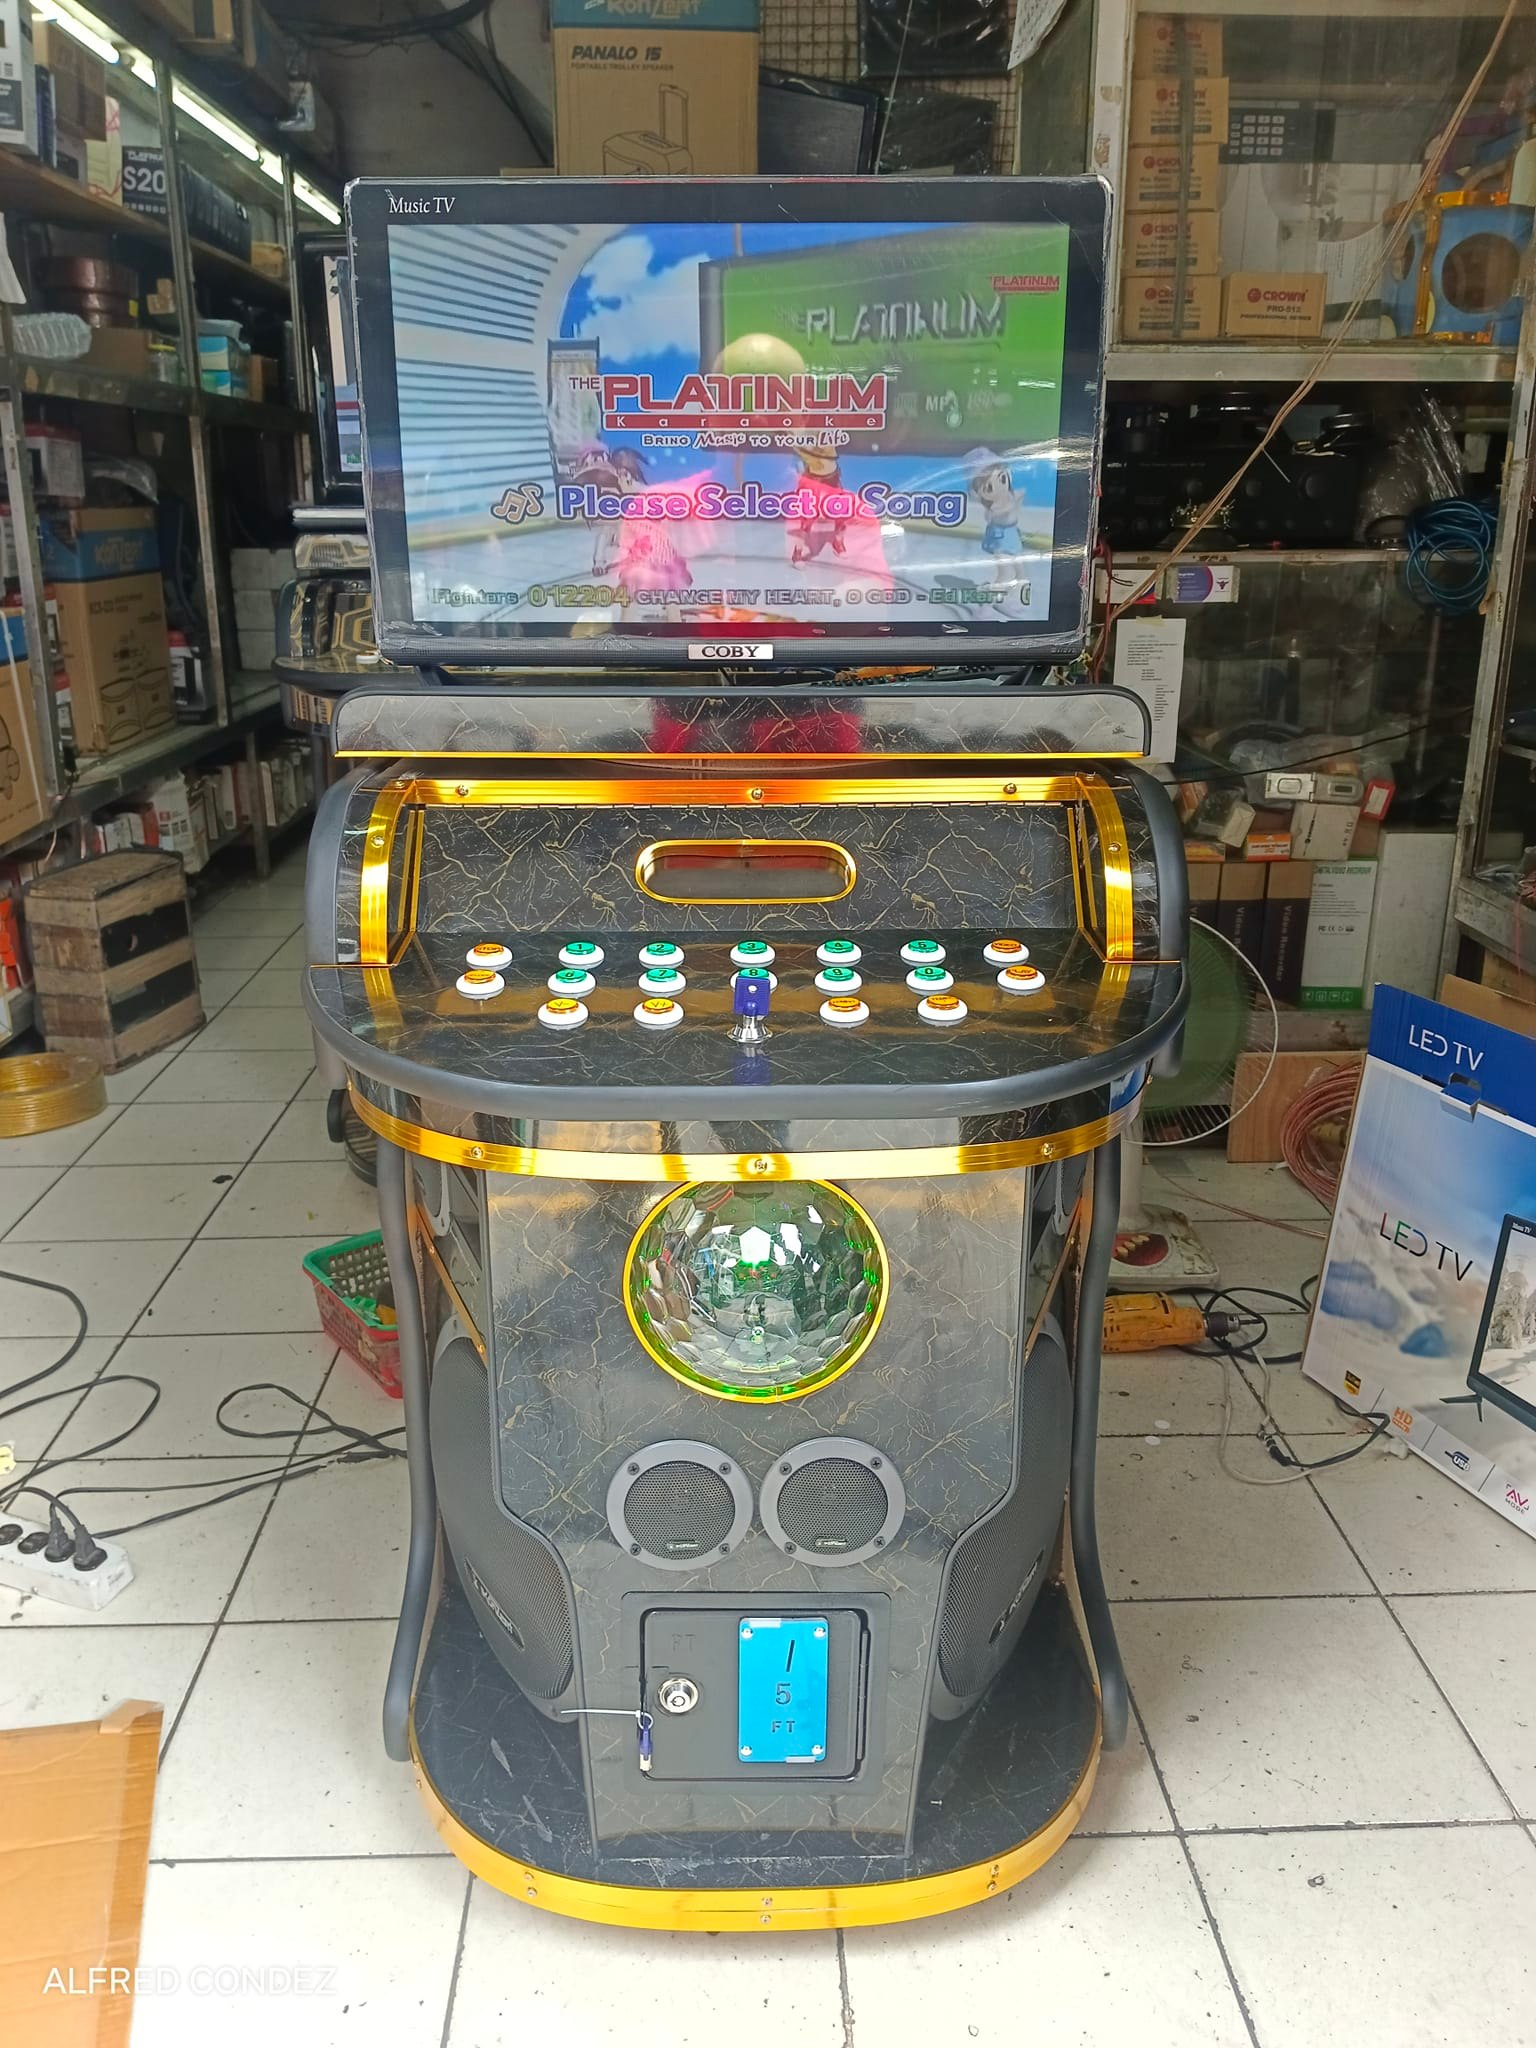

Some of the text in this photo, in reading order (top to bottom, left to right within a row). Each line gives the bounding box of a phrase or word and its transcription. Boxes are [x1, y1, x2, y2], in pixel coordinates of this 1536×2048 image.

[571, 45, 663, 61] PANALO 15
[609, 63, 640, 71] TROLLEY
[123, 166, 166, 194] S20
[389, 196, 456, 213] Music TV
[992, 275, 1060, 287] PLATINUM
[1263, 290, 1306, 302] CROWN
[569, 377, 600, 391] THE
[602, 374, 887, 412] PLATINUM
[642, 430, 850, 449] BRING Music TO YOUR Life
[559, 483, 966, 525] Please Select a Song
[527, 584, 631, 608] 012204
[635, 589, 723, 605] CHANGE
[727, 589, 761, 605] MY
[765, 588, 842, 607] HEART,
[865, 588, 912, 605] GOD
[928, 588, 959, 605] Ed
[701, 645, 760, 658] COBY
[918, 941, 927, 949] 5
[1276, 904, 1293, 982] Video Recorder
[832, 968, 842, 976] 9
[1408, 1024, 1485, 1071] LED TV
[1379, 1212, 1474, 1281] LED TV
[1393, 1406, 1414, 1426] HD
[1453, 1455, 1470, 1472] USB
[1504, 1497, 1526, 1516] MODE
[1506, 1489, 1529, 1507] AV
[775, 1682, 792, 1705] 5
